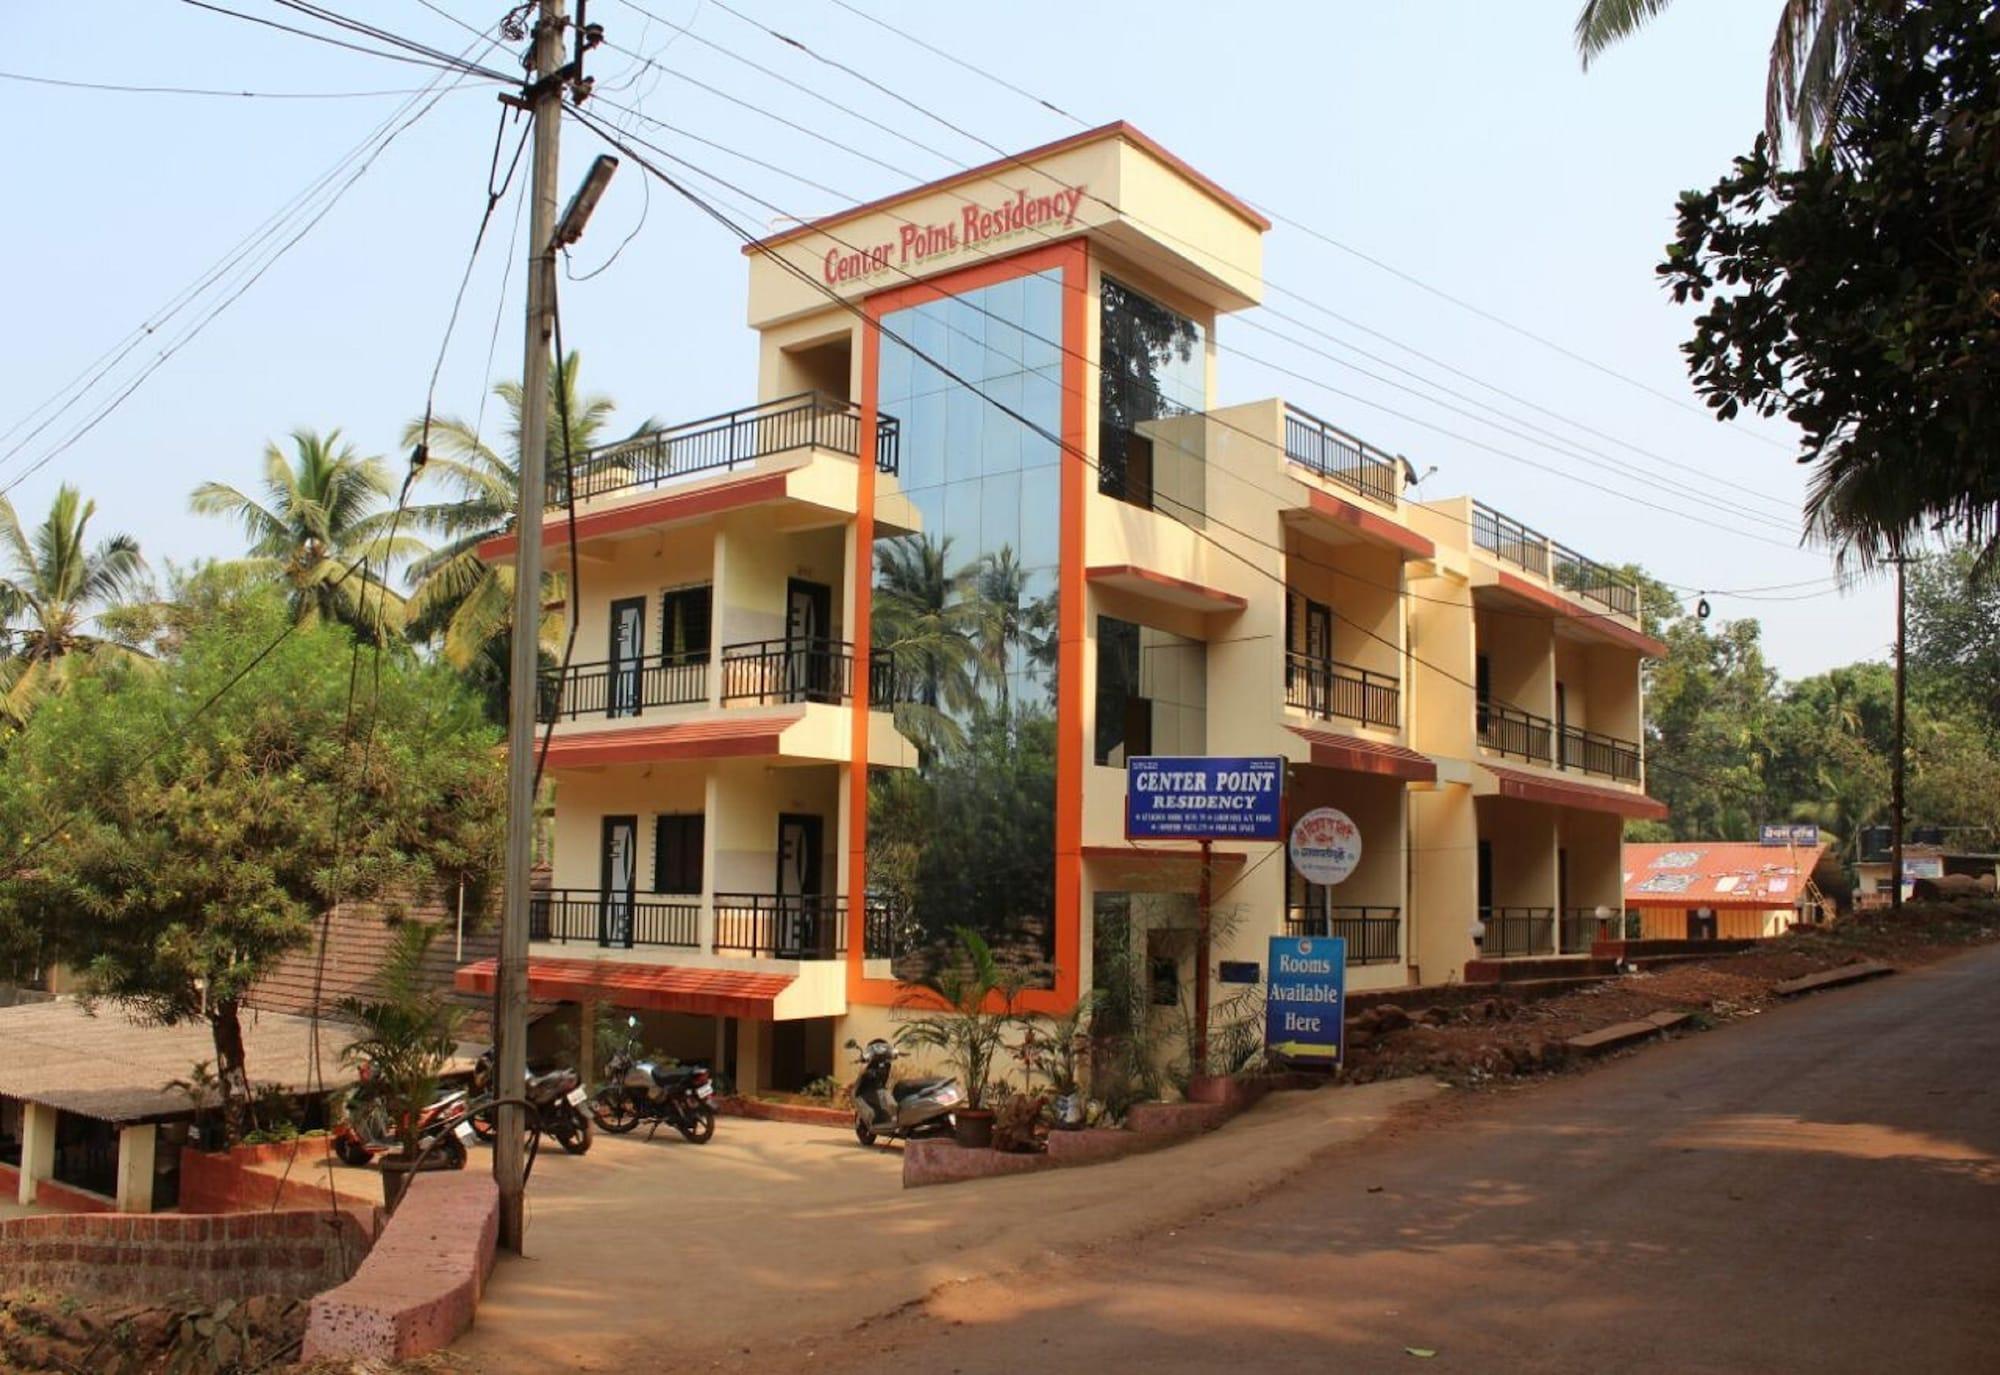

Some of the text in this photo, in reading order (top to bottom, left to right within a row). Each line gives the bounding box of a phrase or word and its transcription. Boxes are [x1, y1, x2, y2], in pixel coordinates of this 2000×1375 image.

[823, 184, 1088, 285] Center Point Residency
[1136, 772, 1275, 792] CENTER POINT
[1152, 796, 1256, 809] RESIDENCY
[1280, 954, 1331, 974] Rooms
[1269, 983, 1338, 1003] Available
[1285, 1012, 1321, 1032] Here
